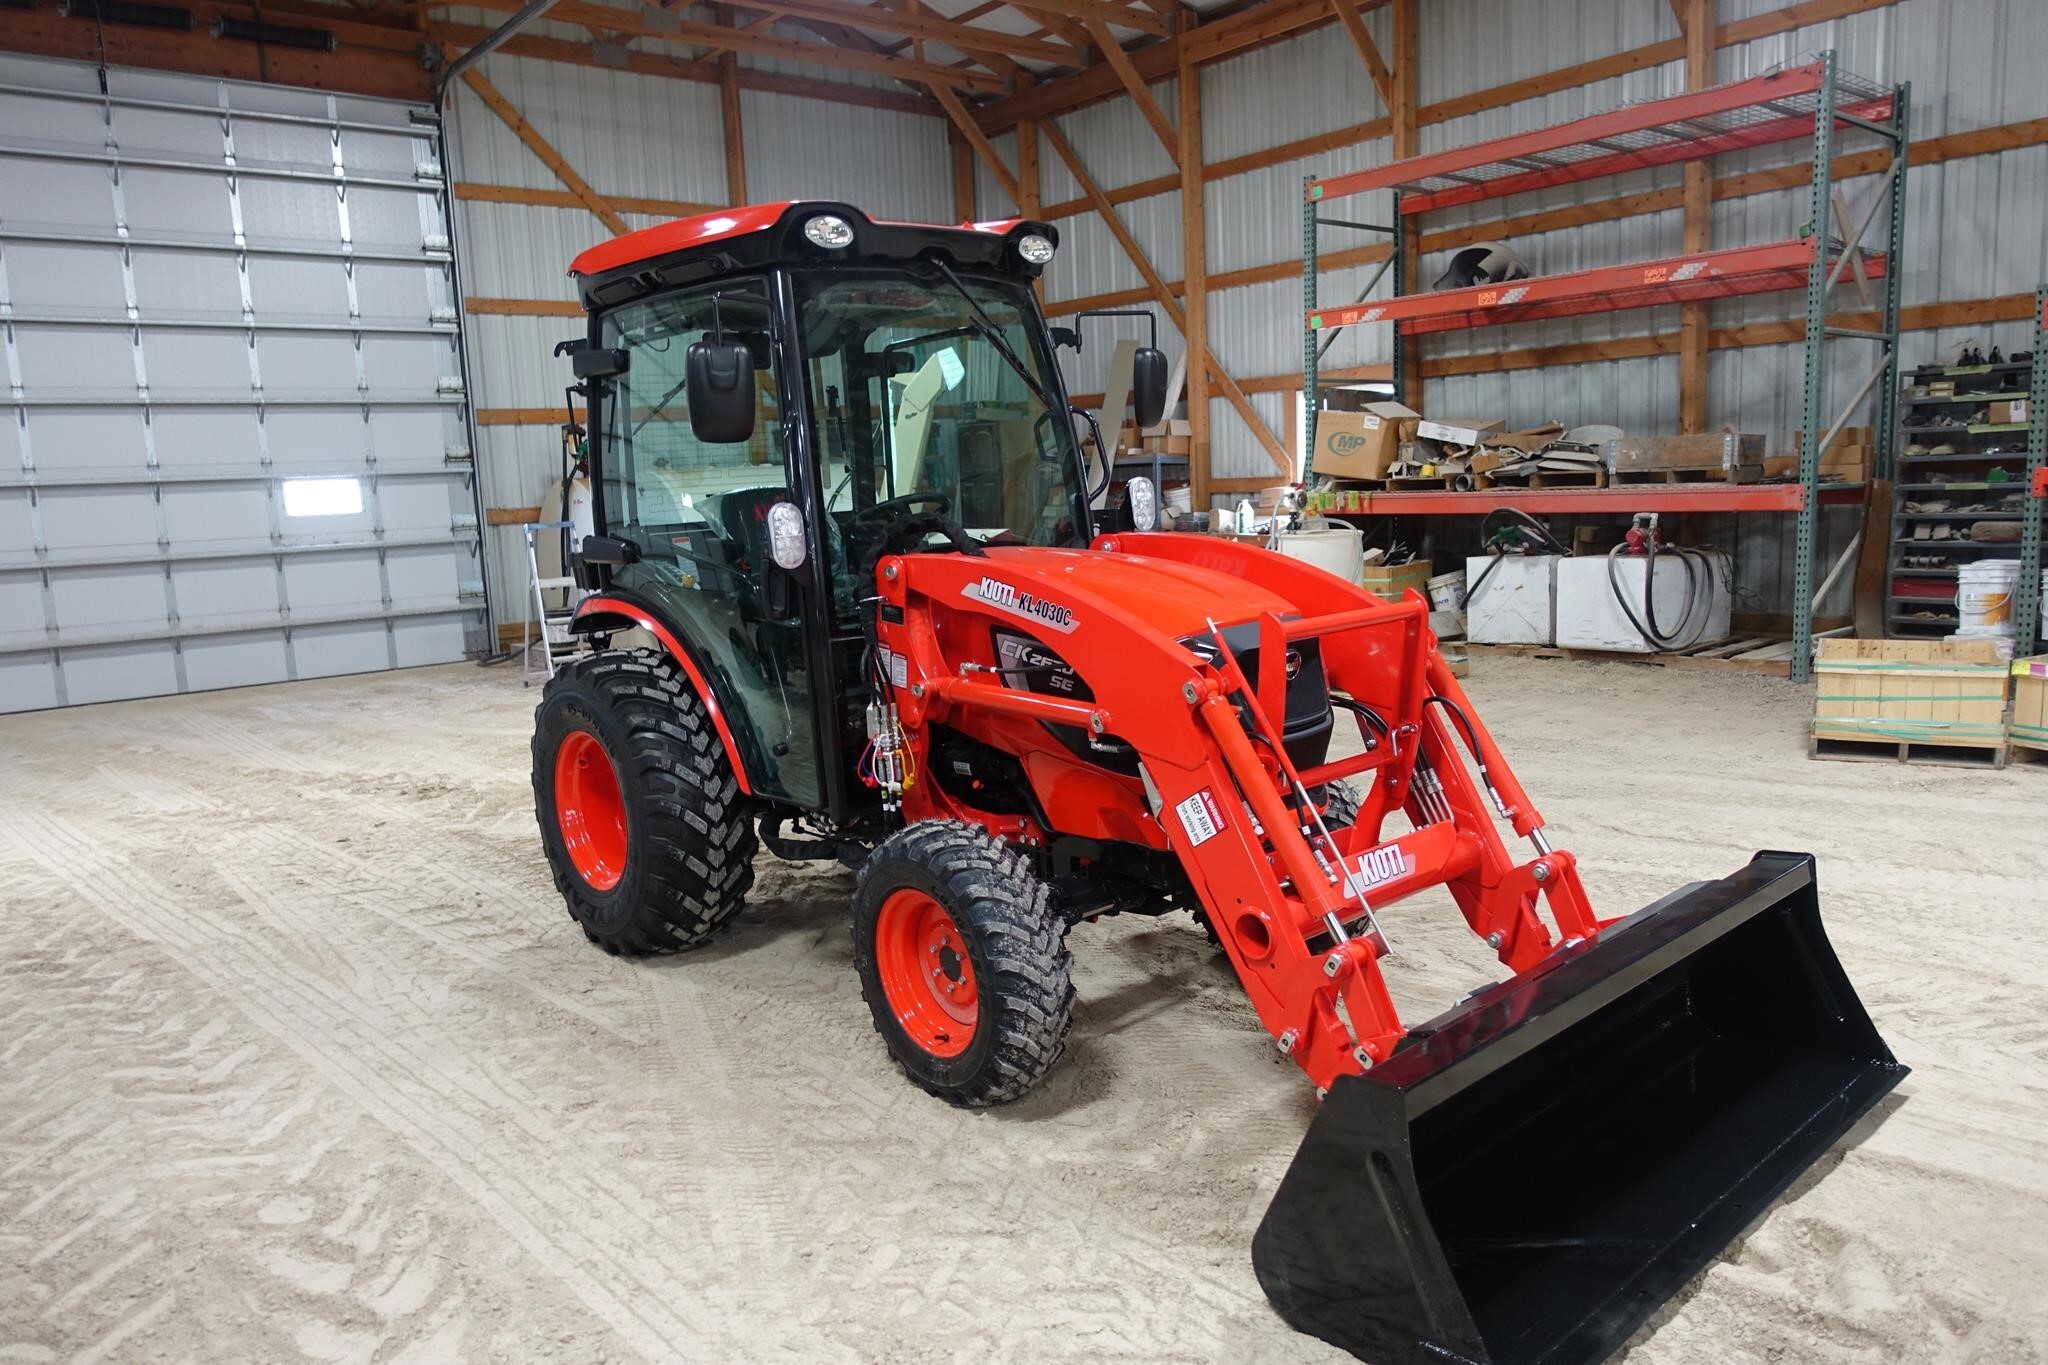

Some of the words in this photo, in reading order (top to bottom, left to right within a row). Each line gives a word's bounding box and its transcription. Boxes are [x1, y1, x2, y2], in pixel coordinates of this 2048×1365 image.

[979, 576, 1016, 607] KIOTI
[1018, 593, 1072, 626] KL4030C
[1049, 675, 1074, 692] SE
[1189, 796, 1203, 815] KEEP
[1198, 816, 1213, 836] AWAY
[1207, 798, 1225, 830] WARNING
[1356, 842, 1407, 887] KIOTI
